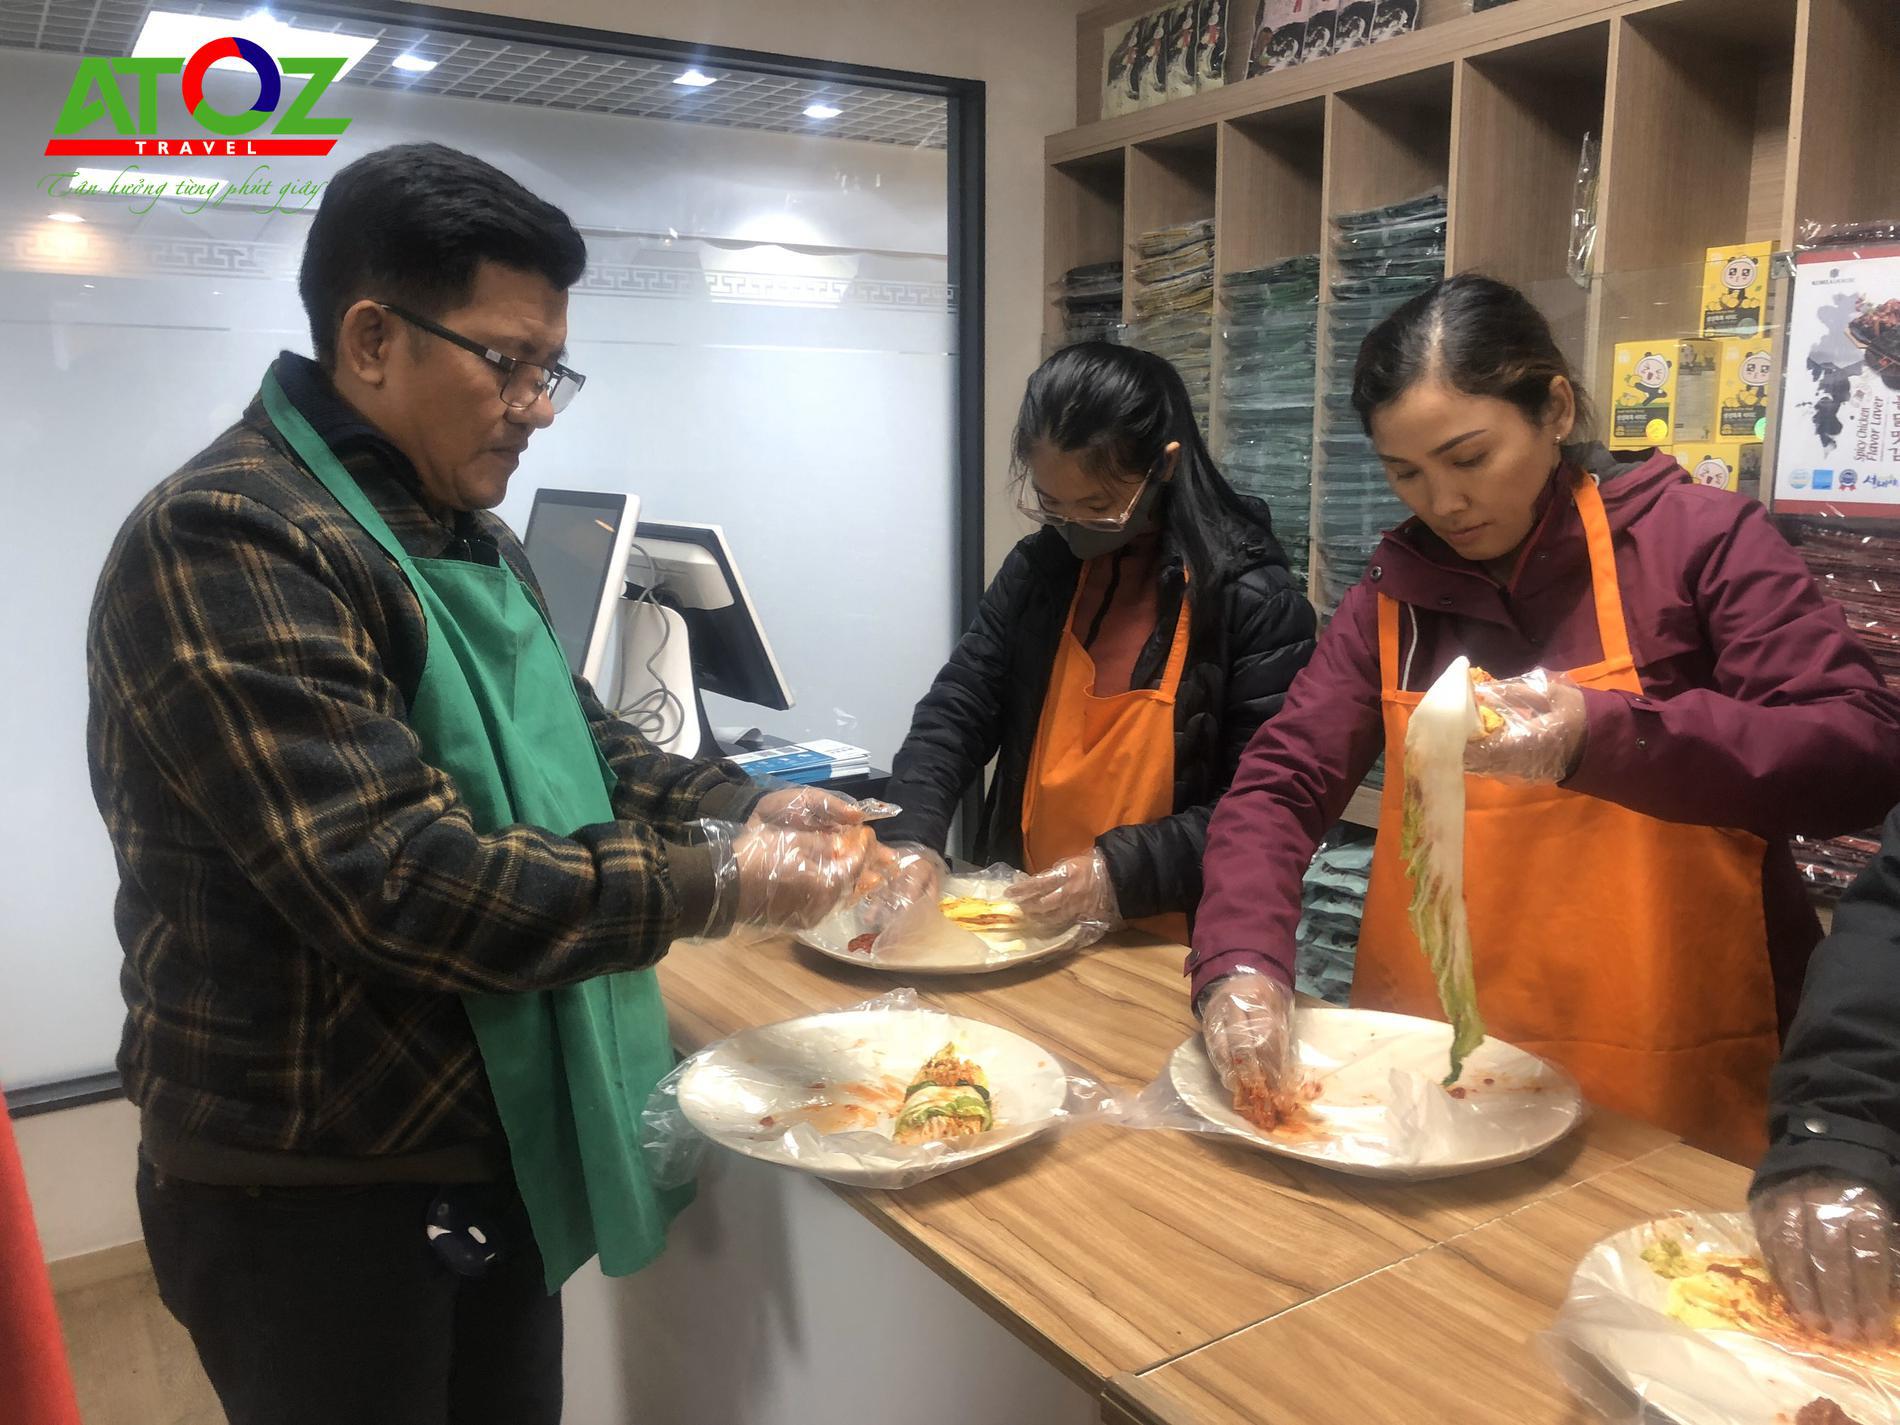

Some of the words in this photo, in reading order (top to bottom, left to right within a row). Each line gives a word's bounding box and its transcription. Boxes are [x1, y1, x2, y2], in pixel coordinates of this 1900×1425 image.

[1856, 407, 1870, 439] Chicken
[1870, 396, 1884, 426] Laver
[1853, 440, 1867, 462] Spicy
[1866, 428, 1880, 462] Flavor
